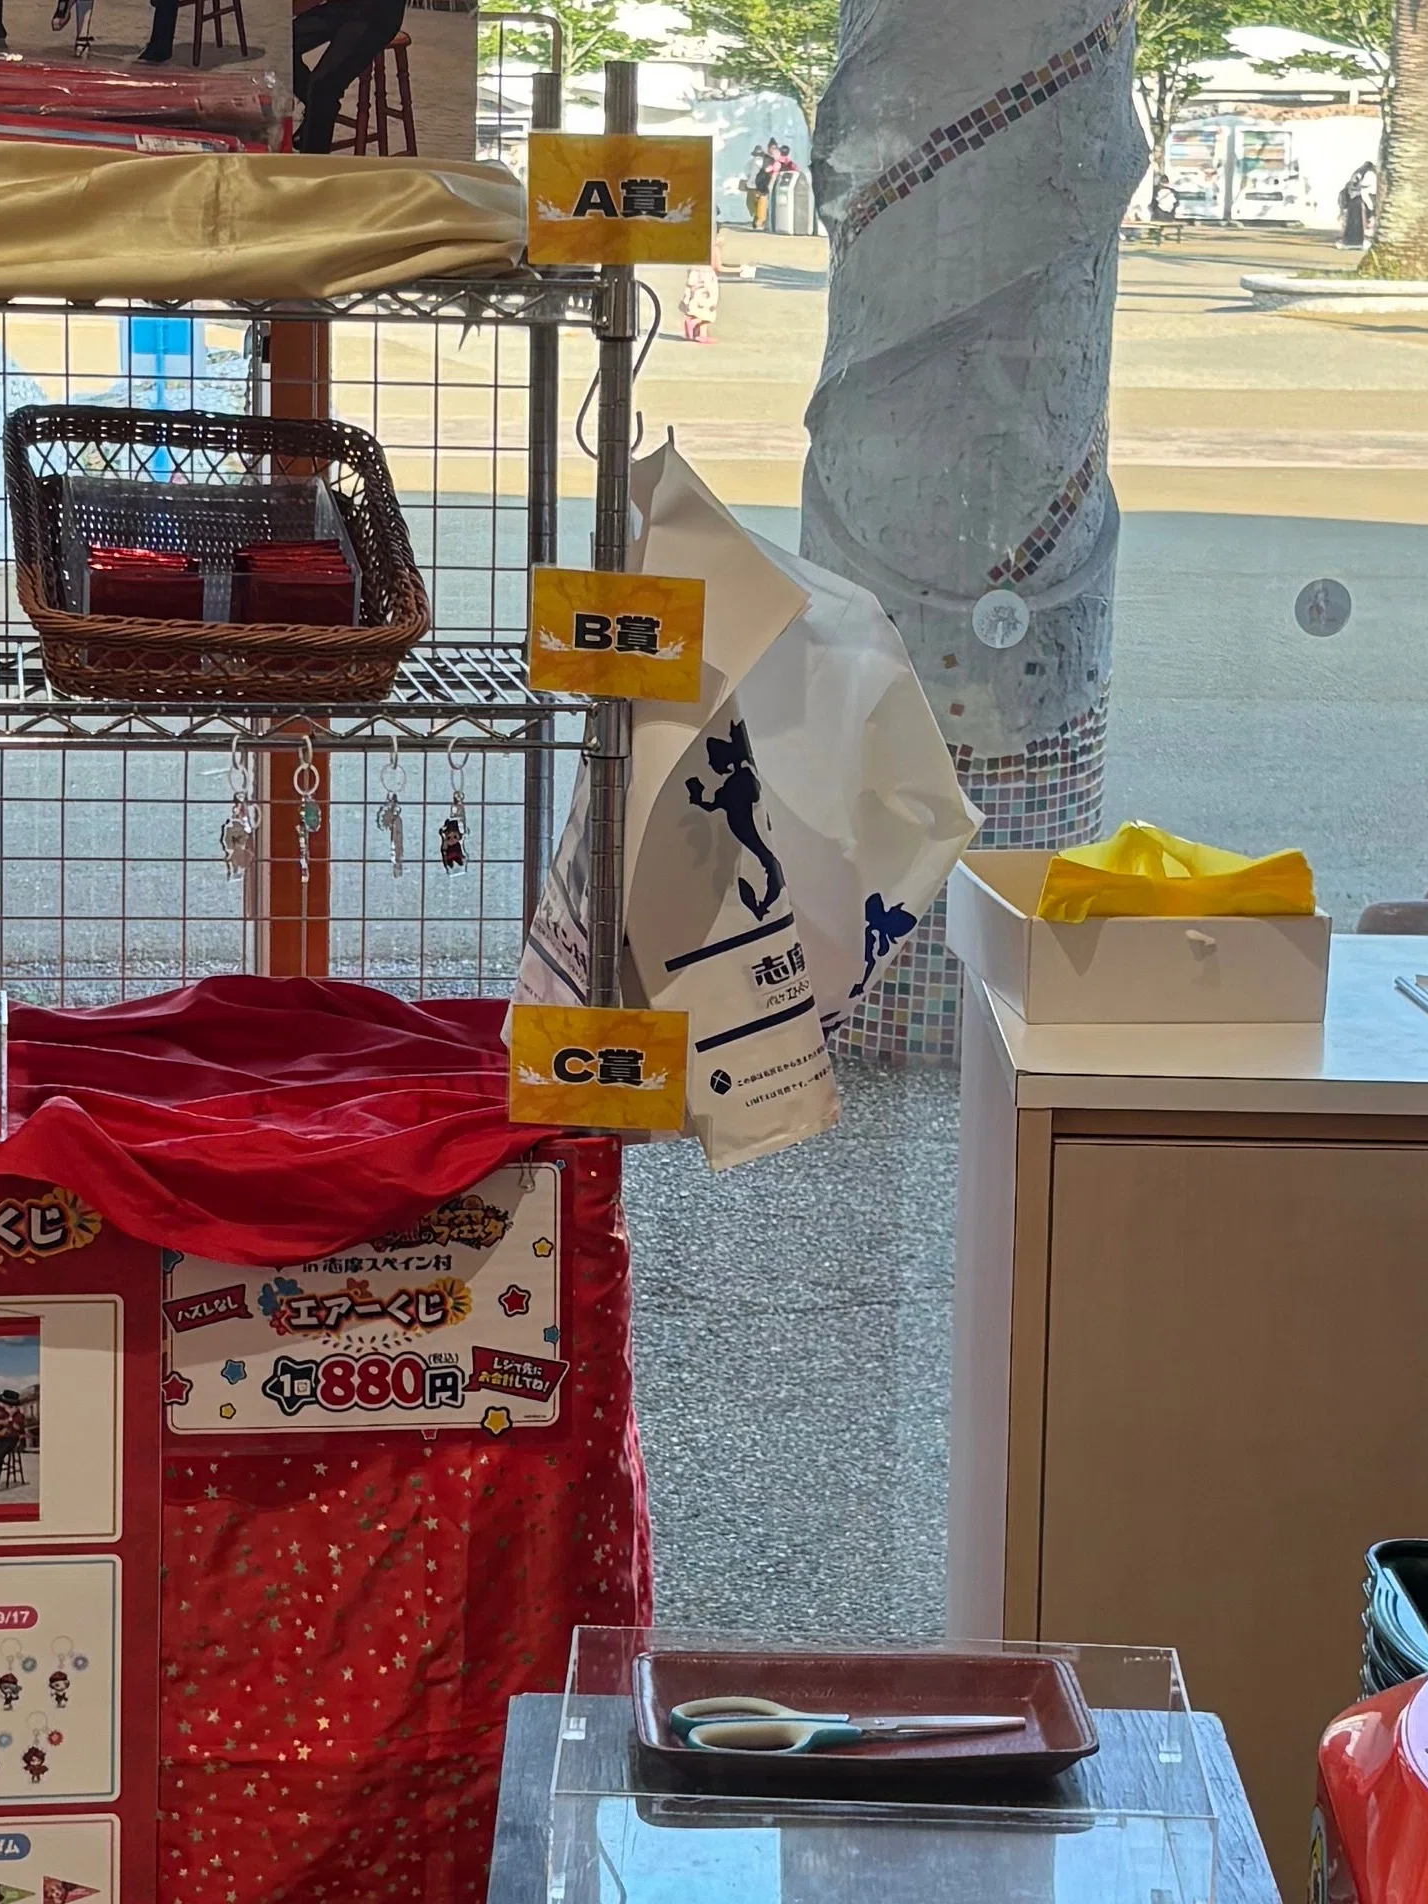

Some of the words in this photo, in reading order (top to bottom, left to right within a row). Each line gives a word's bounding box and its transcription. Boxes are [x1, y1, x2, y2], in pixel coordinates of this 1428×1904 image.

[572, 179, 669, 219] A賞
[574, 613, 661, 655] B賞
[552, 1048, 644, 1087] C賞
[177, 1295, 239, 1322] ハズレなし
[290, 1291, 445, 1328] エアーくじ
